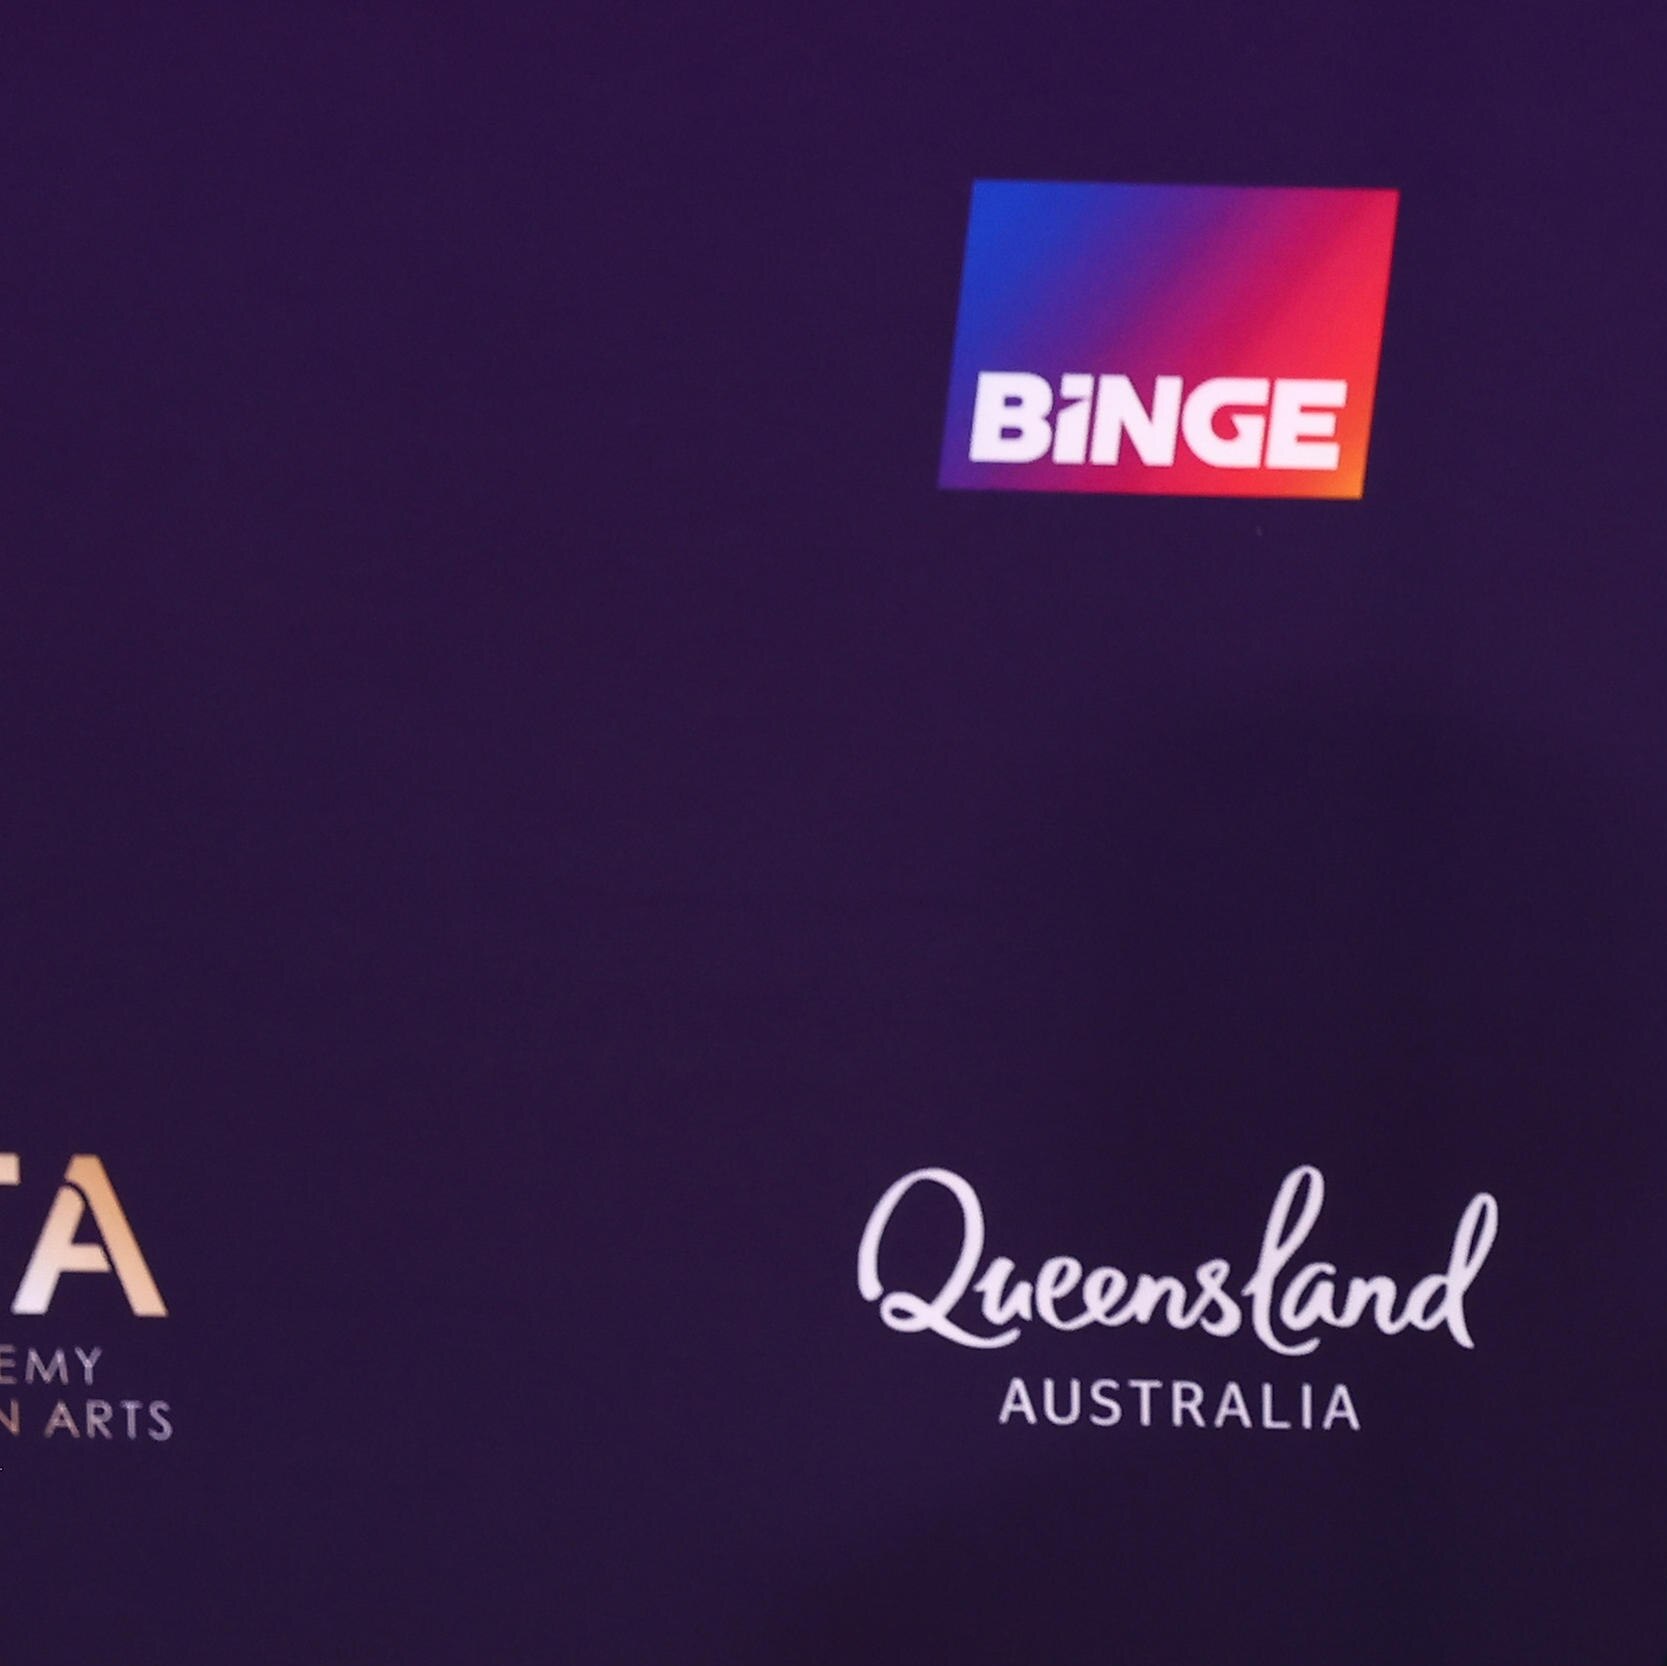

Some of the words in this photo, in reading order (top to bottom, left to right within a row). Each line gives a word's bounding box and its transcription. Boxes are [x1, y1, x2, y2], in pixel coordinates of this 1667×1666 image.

[857, 1164, 1499, 1357] Queensland
[44, 1399, 174, 1442] ARTS
[998, 1377, 1361, 1432] AUSTRALIA
